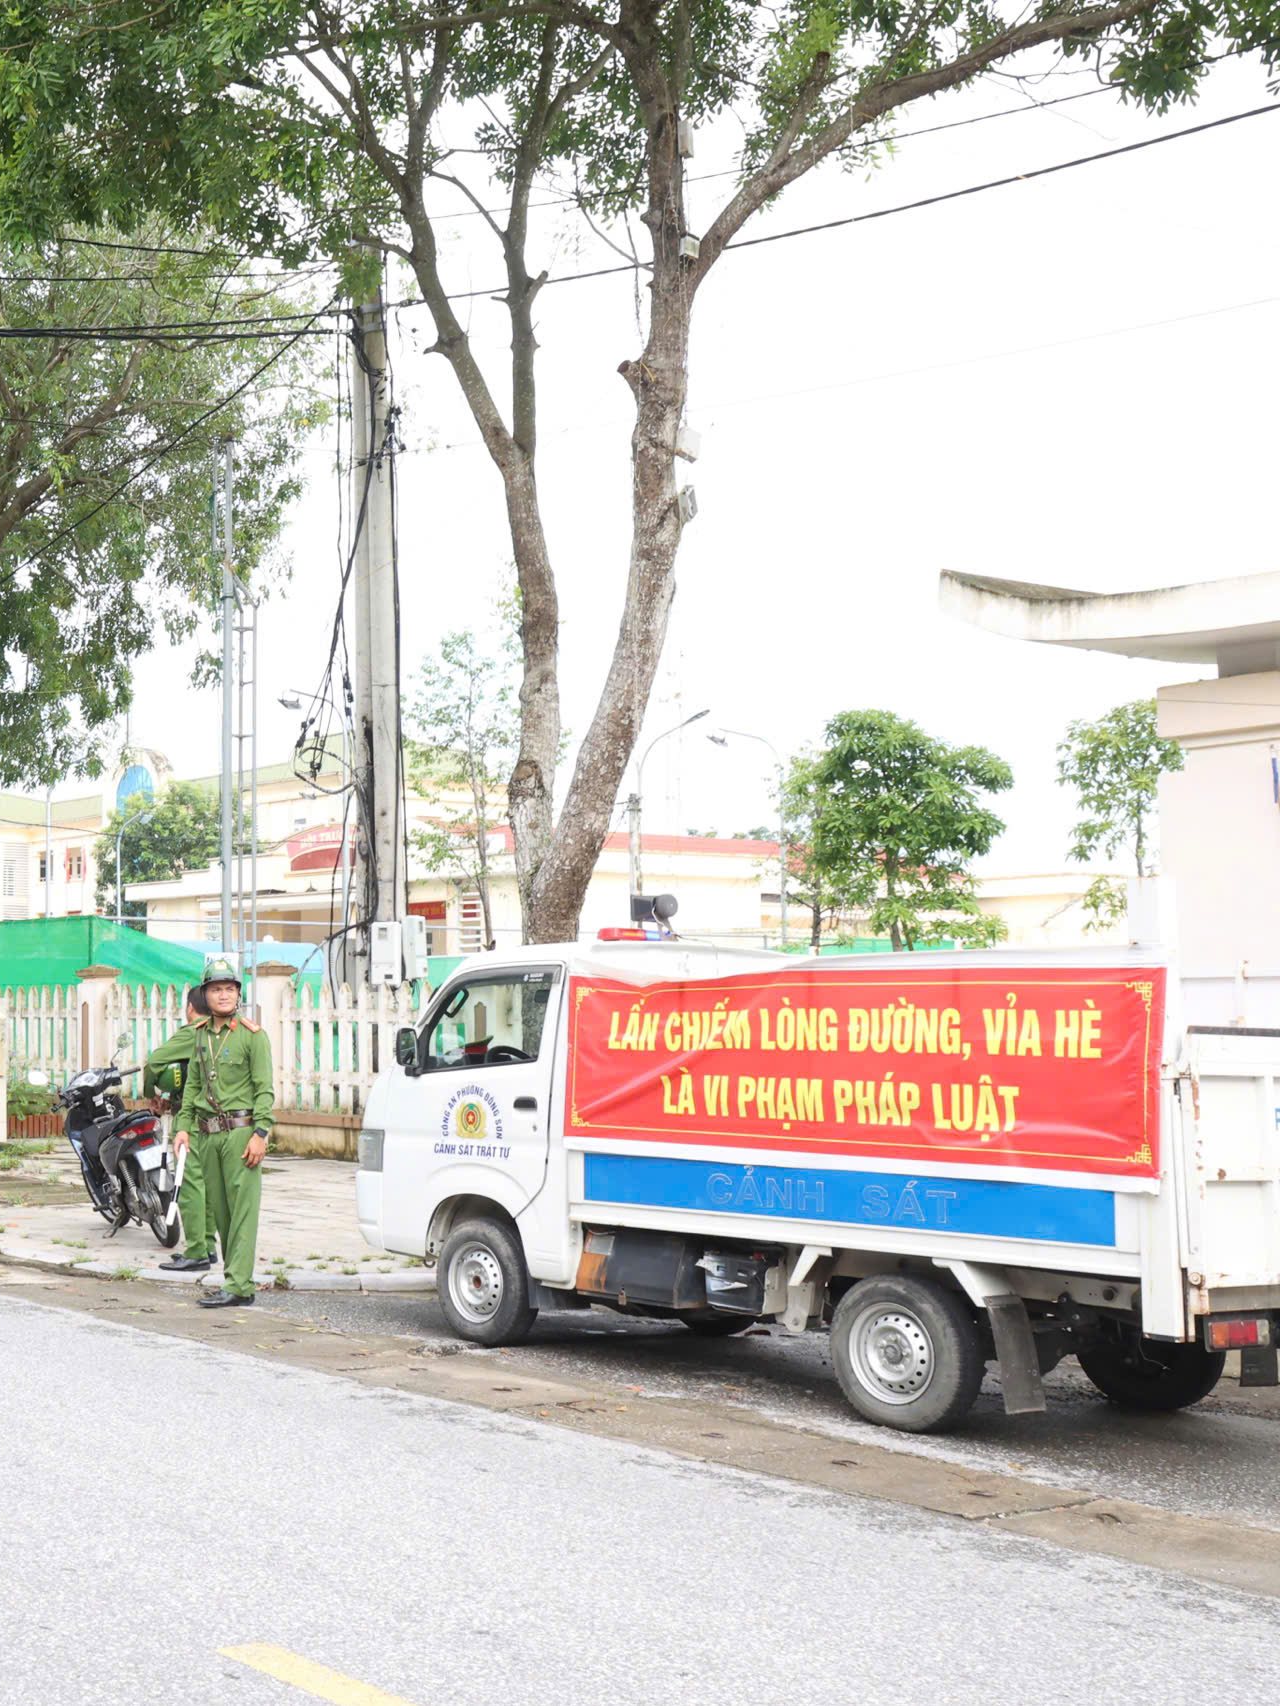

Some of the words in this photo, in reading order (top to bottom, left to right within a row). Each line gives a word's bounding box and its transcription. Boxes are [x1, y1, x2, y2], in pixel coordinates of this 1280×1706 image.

[608, 998, 660, 1051] LẤN
[664, 997, 751, 1052] CHIẾM
[759, 996, 838, 1052] LÒNG
[848, 997, 971, 1061] ĐƯỜNG,
[982, 992, 1042, 1057] VỈA
[1054, 999, 1102, 1059] HÈ
[448, 1096, 457, 1109] AN
[660, 1066, 696, 1116] LÀ
[703, 1074, 729, 1117] VI
[737, 1075, 825, 1130] PHẠM
[833, 1072, 920, 1127] PHÁP
[931, 1074, 1020, 1142] LUẬT
[706, 1165, 825, 1213] CẢNH
[861, 1180, 957, 1225] SÁT
